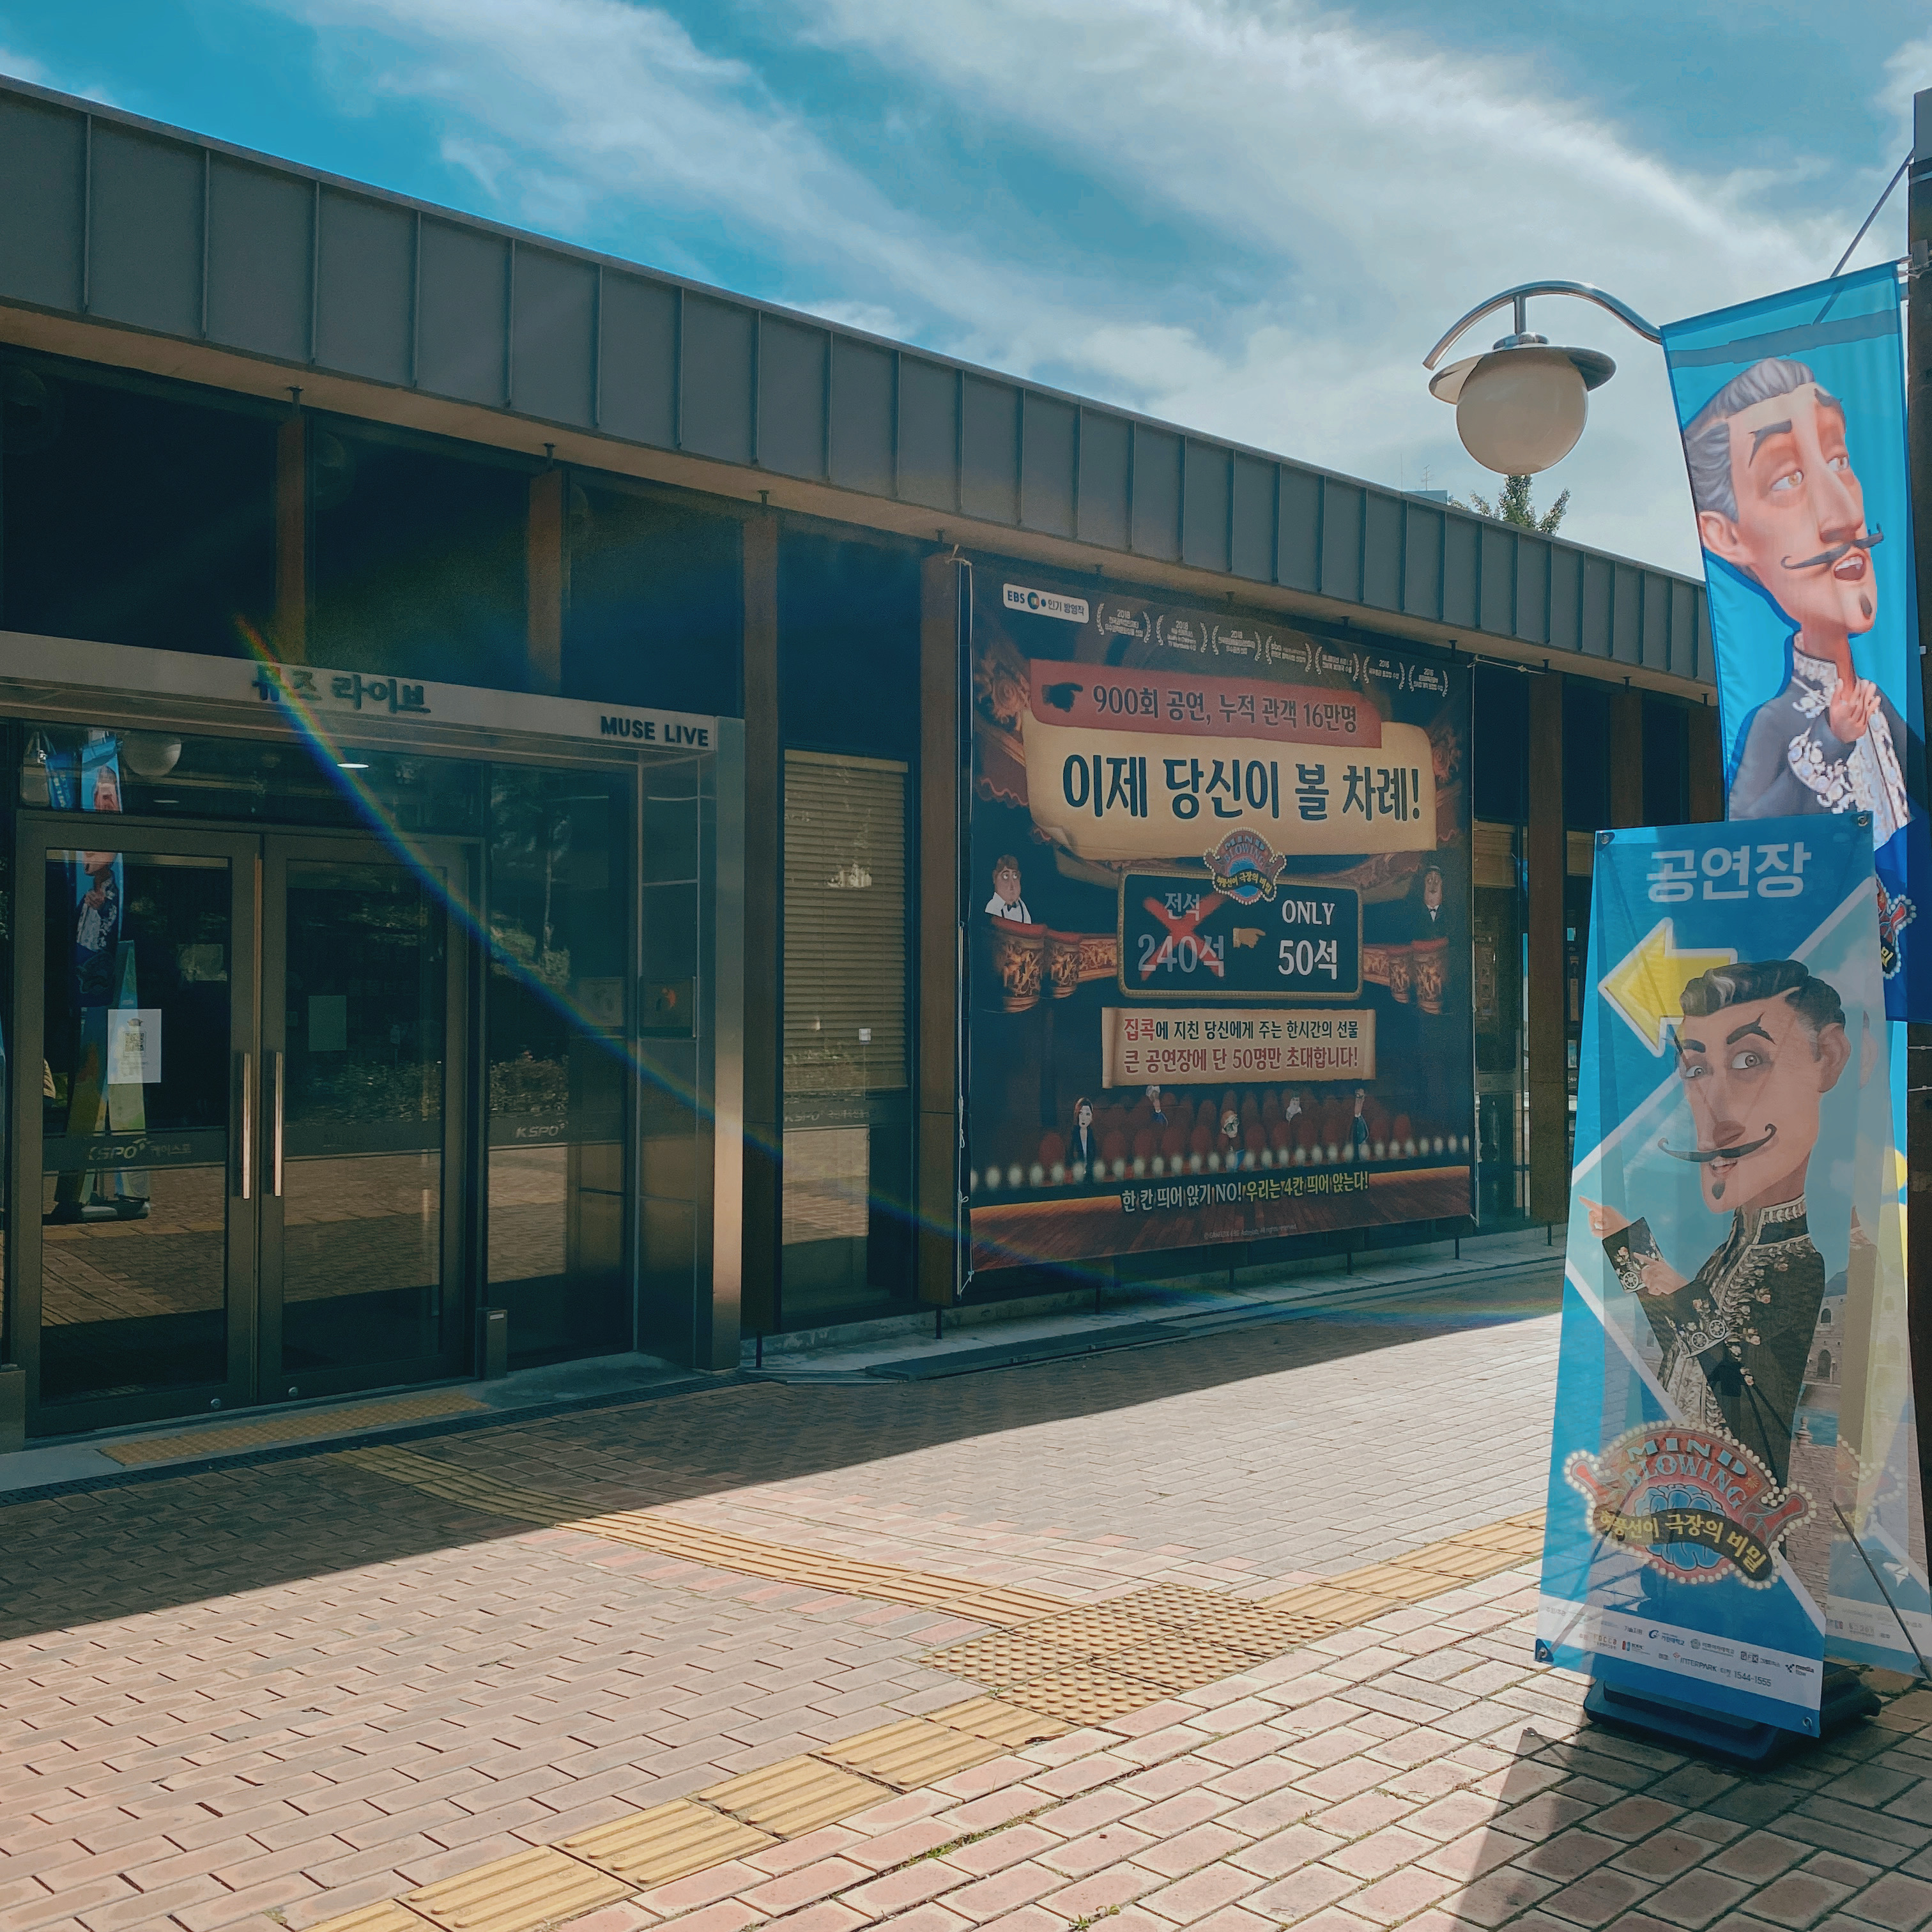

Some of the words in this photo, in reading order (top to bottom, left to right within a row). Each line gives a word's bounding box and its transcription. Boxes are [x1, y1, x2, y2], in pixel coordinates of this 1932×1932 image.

[1008, 590, 1025, 604] EBS
[1048, 599, 1062, 611] 인기
[331, 674, 431, 714] 라이브
[1094, 685, 1158, 718] 900회
[1166, 691, 1211, 725] 공연,
[1219, 694, 1255, 723] 누적
[1262, 698, 1297, 728] 관객
[1303, 702, 1357, 733] 16만명
[600, 716, 656, 740] MUSE
[664, 724, 709, 747] LIVE
[1062, 754, 1148, 818] 이제
[1163, 758, 1279, 820] 당신이
[1295, 763, 1329, 821] 볼
[1342, 765, 1420, 822] 차례!
[1224, 835, 1265, 851] MIND
[1239, 871, 1259, 884] 극장의
[1259, 877, 1273, 894] 비밀
[1646, 841, 1812, 903] 공연장
[1164, 892, 1200, 921] 전석
[1282, 900, 1336, 926] ONLY
[1138, 934, 1225, 977] 240석
[1278, 939, 1338, 980] 50석
[1123, 1018, 1169, 1041] 집콕에
[1173, 1019, 1199, 1041] 지친
[1204, 1020, 1254, 1040] 당신에게
[1259, 1020, 1282, 1039] 주는
[1286, 1020, 1333, 1039] 한시간의
[1337, 1020, 1358, 1039] 선물
[1123, 1050, 1140, 1074] 큰
[1146, 1049, 1208, 1073] 공연장에
[1213, 1048, 1227, 1071] 단
[1232, 1048, 1282, 1070] 50명만
[1286, 1046, 1358, 1068] 초대합니다!
[516, 1125, 559, 1139] KSPO
[1122, 1191, 1136, 1212] 한
[1140, 1190, 1153, 1210] 칸
[1156, 1187, 1183, 1208] 띄어
[1186, 1185, 1213, 1206] 앉기
[1216, 1183, 1242, 1202] NO!
[1245, 1179, 1280, 1201] 우리는
[1284, 1177, 1305, 1197] 4칸
[1307, 1174, 1330, 1195] 띄어
[1333, 1171, 1369, 1193] 앉는다!
[1626, 1438, 1750, 1478] MIND
[1623, 1453, 1749, 1511] BLOWING
[1598, 1509, 1660, 1538] 허풍선이
[1664, 1514, 1724, 1539] 극장의
[1727, 1533, 1768, 1573] 비밀
[1680, 1657, 1717, 1673] INTERPARK
[1734, 1671, 1772, 1687] 1544-1555
